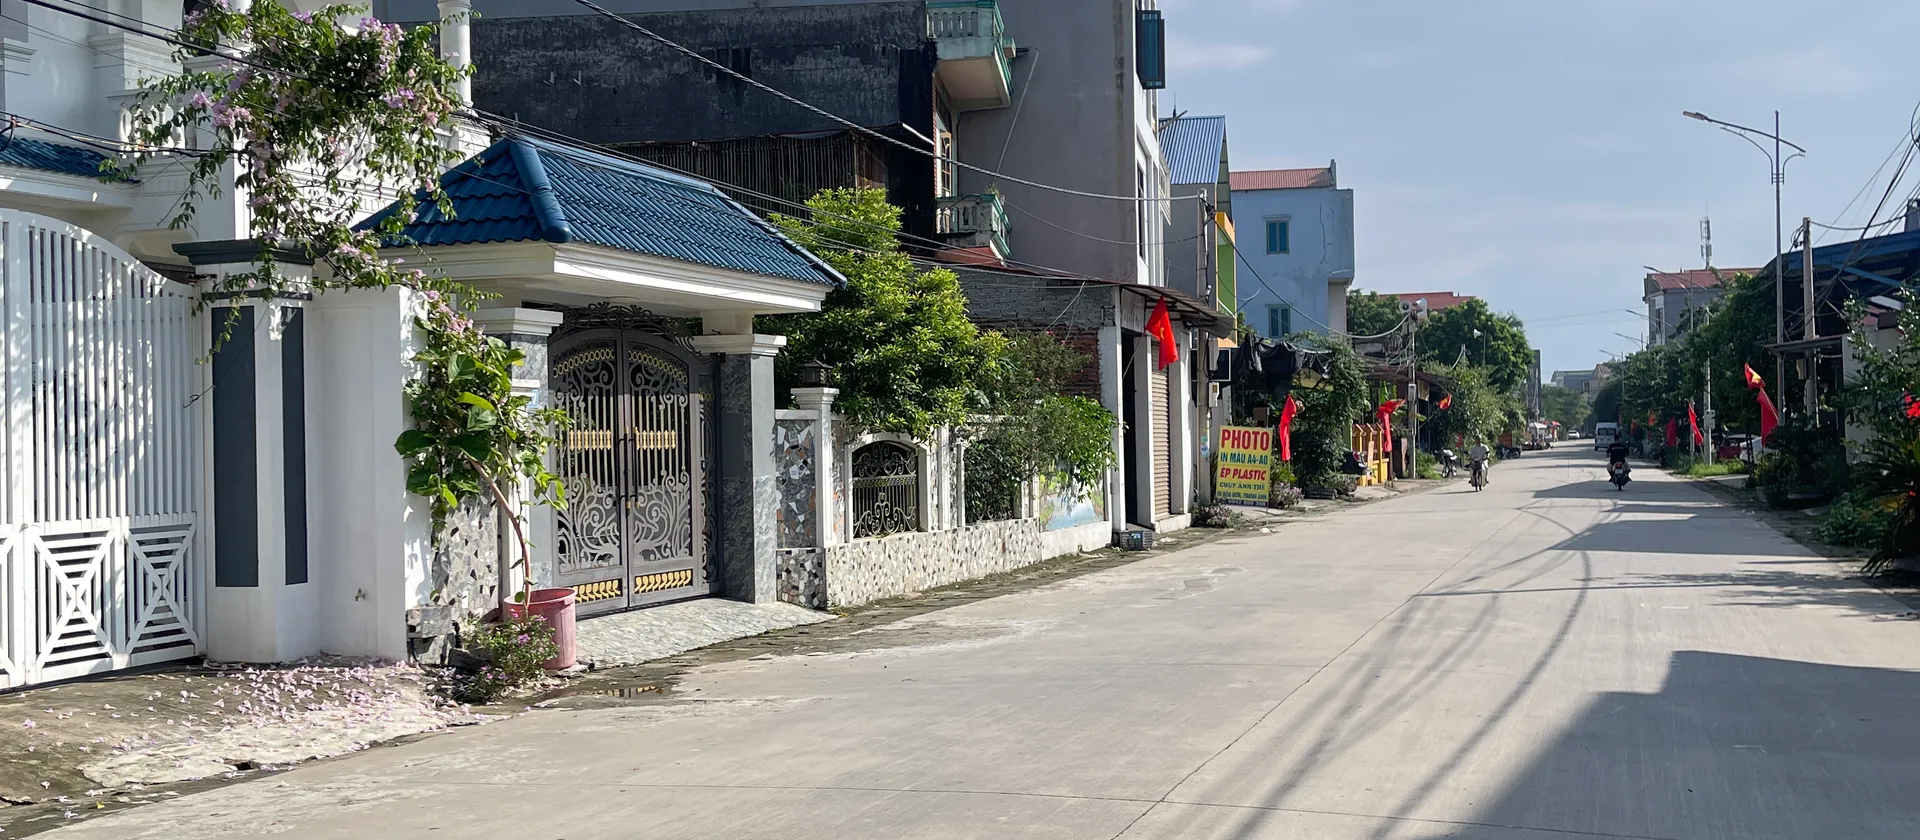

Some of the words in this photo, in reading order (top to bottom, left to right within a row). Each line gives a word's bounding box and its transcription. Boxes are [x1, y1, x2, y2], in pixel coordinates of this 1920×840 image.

[1221, 429, 1269, 451] PHOTO
[1220, 452, 1228, 462] IN
[1220, 464, 1231, 478] ÉP
[1232, 468, 1266, 480] PLASTIC
